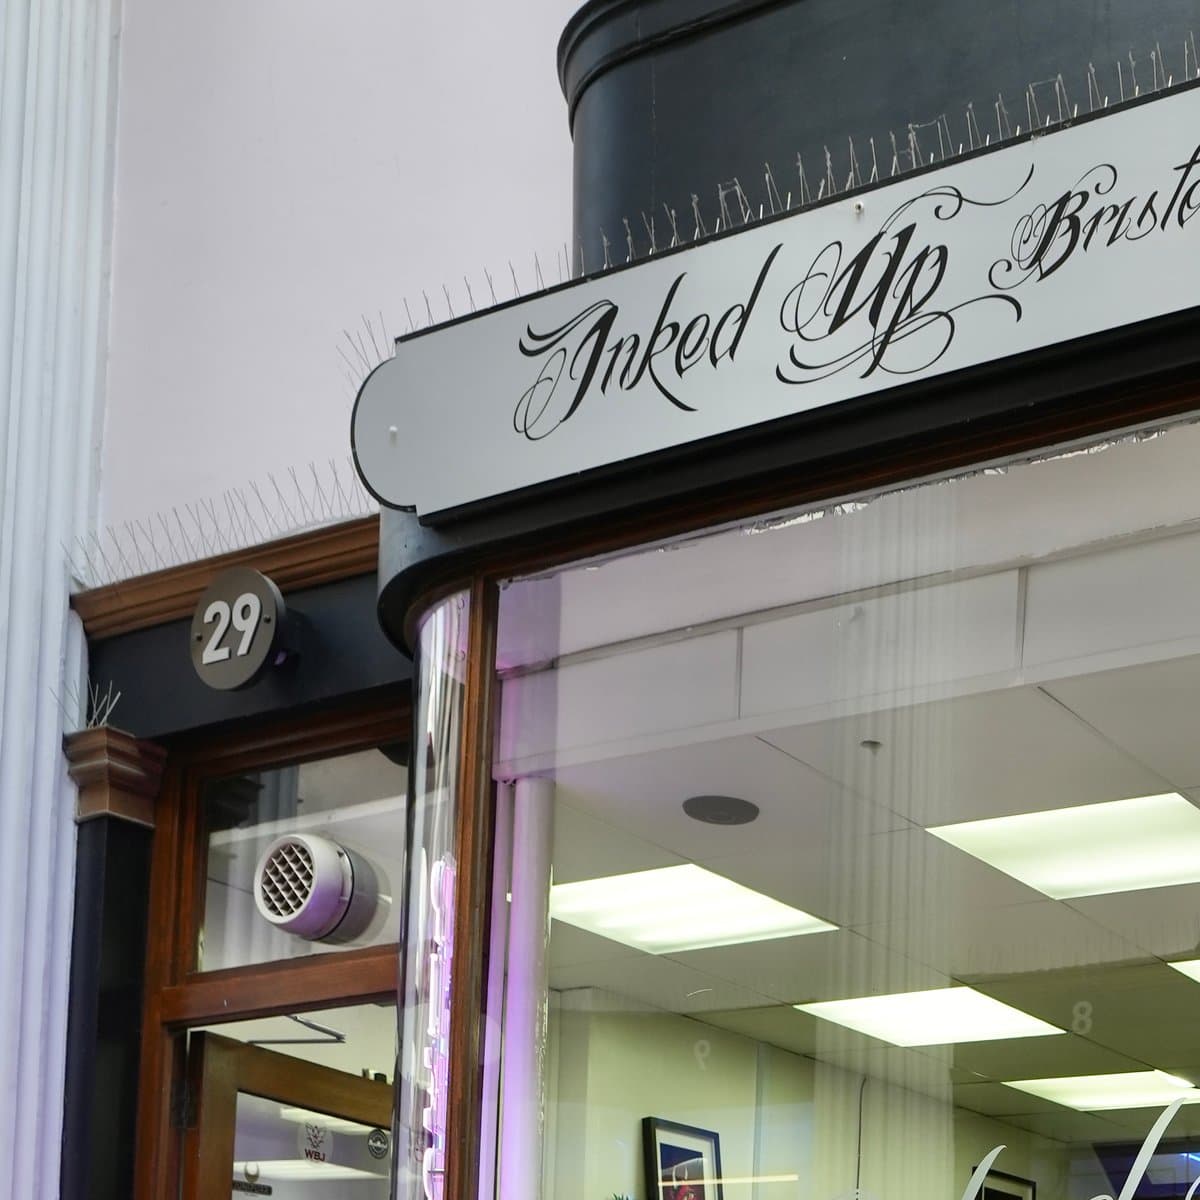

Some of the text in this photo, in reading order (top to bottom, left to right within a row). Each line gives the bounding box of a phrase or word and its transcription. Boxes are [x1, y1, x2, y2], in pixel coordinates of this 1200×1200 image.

[513, 244, 782, 441] Inked
[776, 162, 1034, 384] Up
[202, 592, 262, 664] 29
[304, 1149, 326, 1162] WBJ
